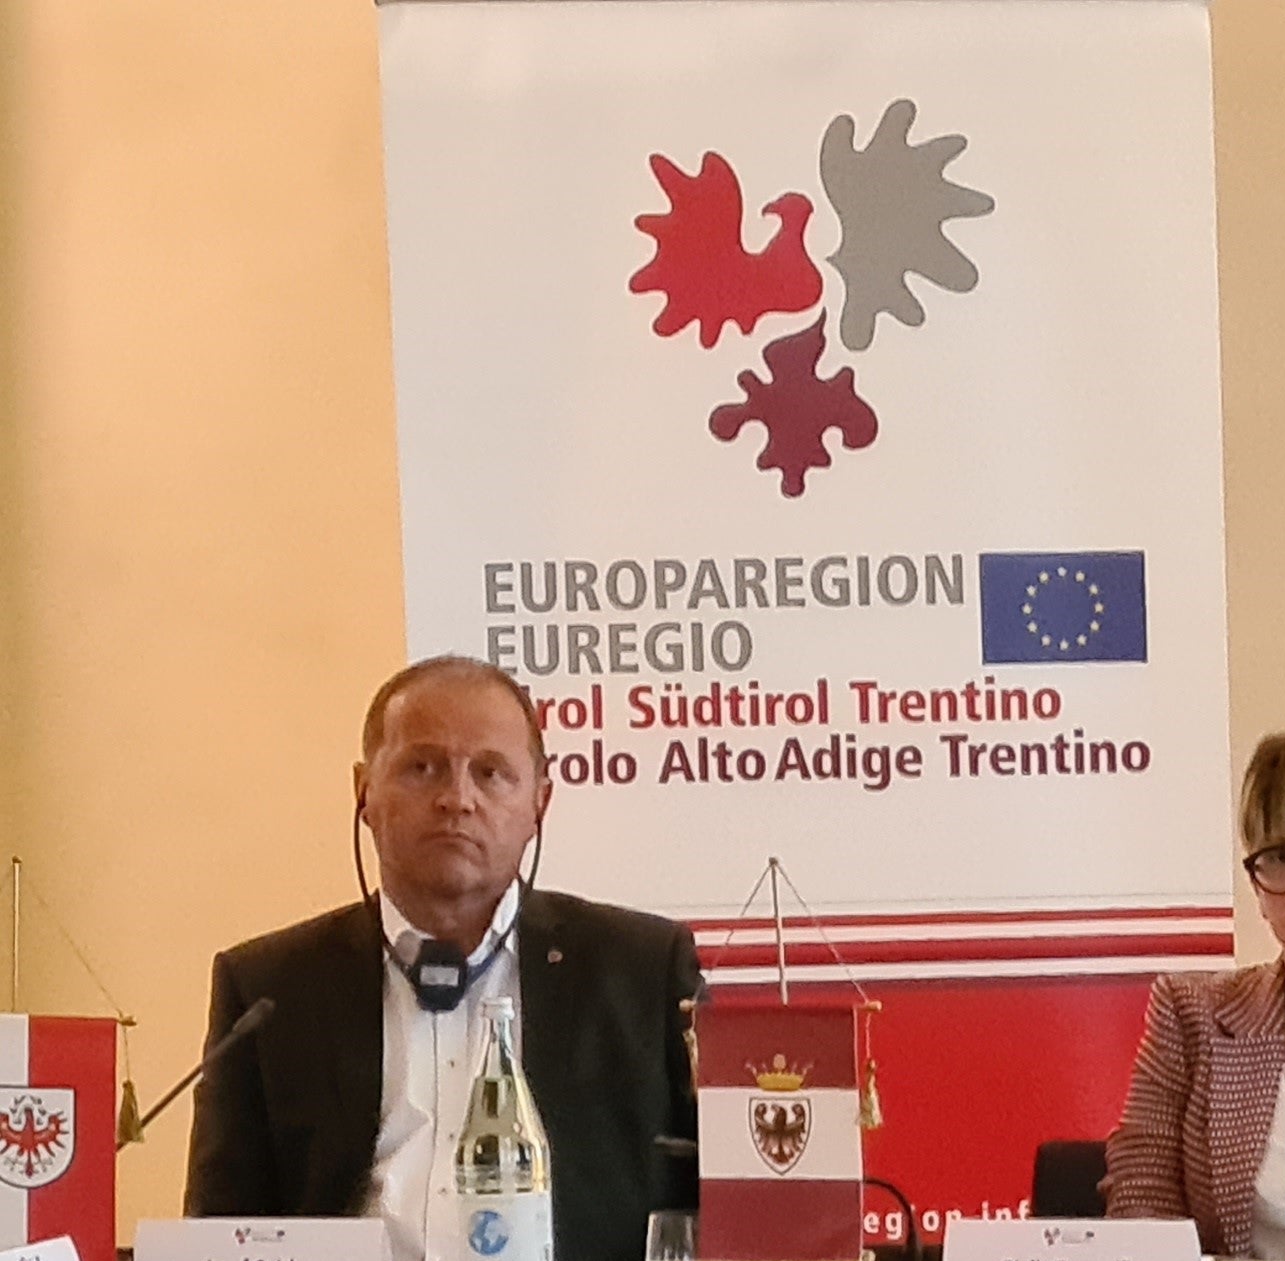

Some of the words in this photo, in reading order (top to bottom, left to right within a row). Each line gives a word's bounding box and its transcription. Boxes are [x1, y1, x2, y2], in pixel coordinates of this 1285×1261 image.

[484, 553, 964, 613] EUROPAREGION
[487, 620, 752, 676] EUREGIO
[521, 684, 603, 730] rol
[628, 678, 829, 729] Südtirol
[850, 675, 1061, 724] Trentino
[545, 739, 637, 785] rolo
[658, 736, 767, 784] Alto
[775, 733, 922, 792] Adige
[940, 727, 1151, 778] Trentino
